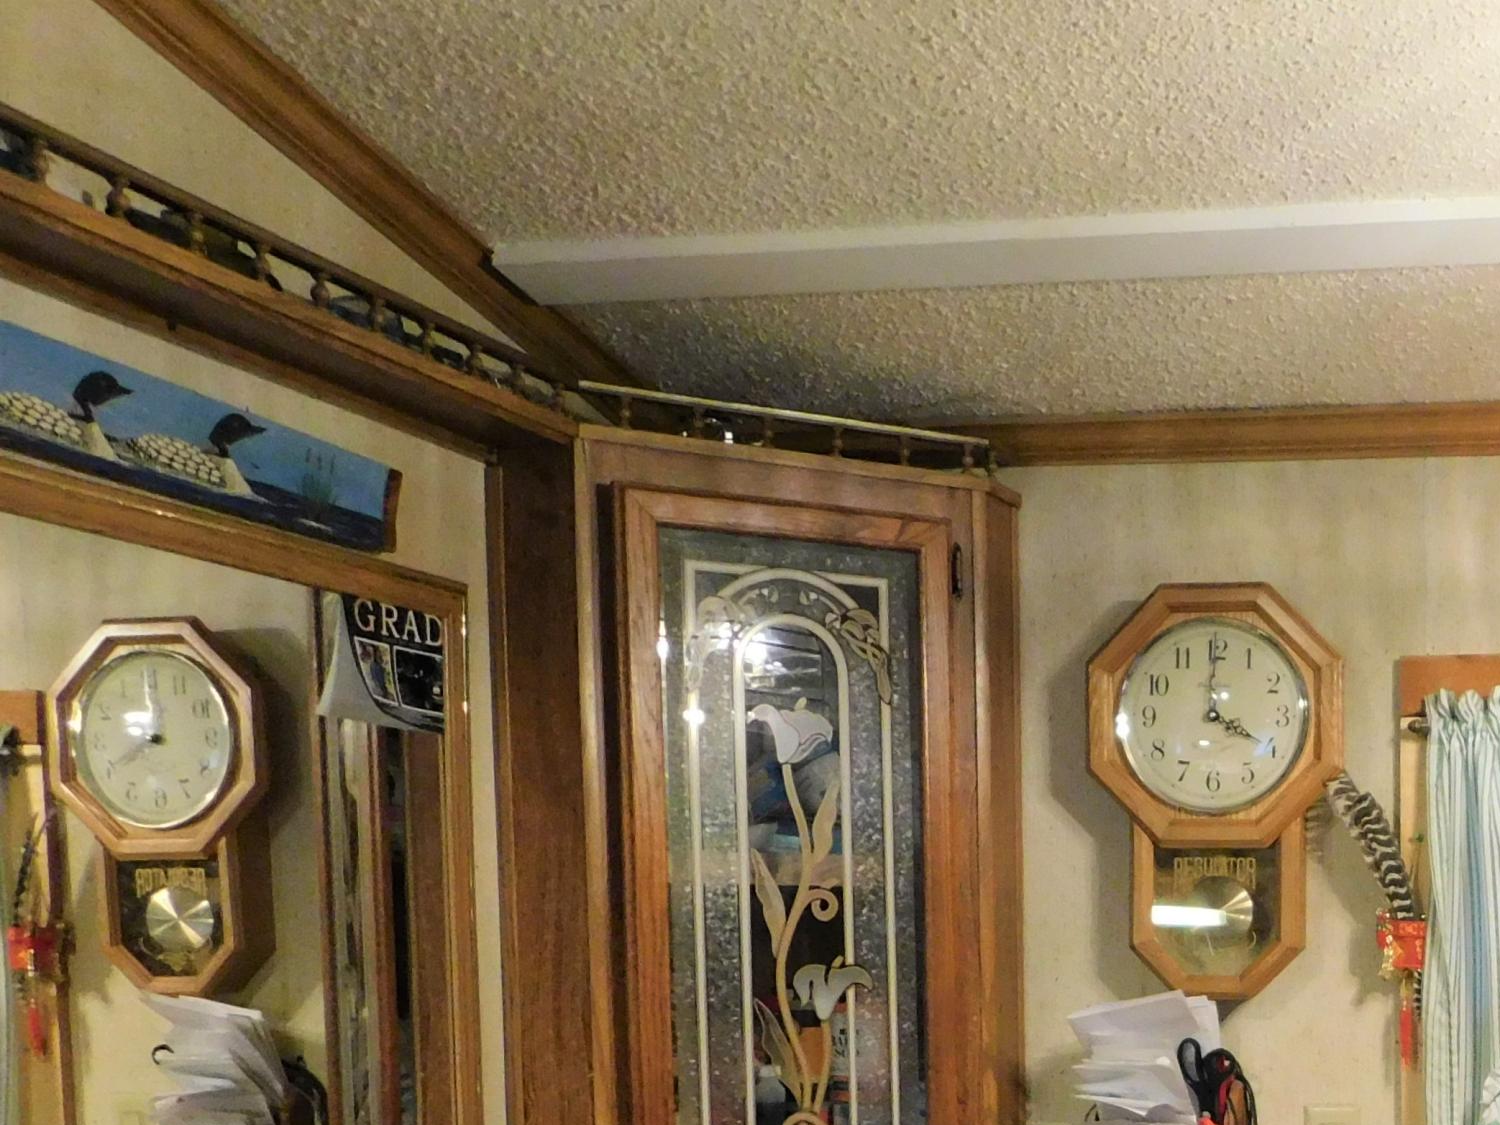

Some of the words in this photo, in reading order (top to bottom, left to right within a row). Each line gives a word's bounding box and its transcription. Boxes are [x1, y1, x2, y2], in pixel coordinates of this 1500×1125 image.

[354, 599, 442, 646] GRAD
[1175, 647, 1190, 669] 11
[1208, 640, 1228, 661] 12
[1245, 648, 1253, 669] 1
[1148, 674, 1169, 696] 10
[1267, 673, 1280, 694] 2
[1142, 706, 1157, 728] 9
[1275, 705, 1289, 727] 3
[1151, 739, 1166, 761] 8
[1177, 760, 1190, 782] 7
[1206, 770, 1220, 792] 6
[1241, 762, 1255, 784] 5
